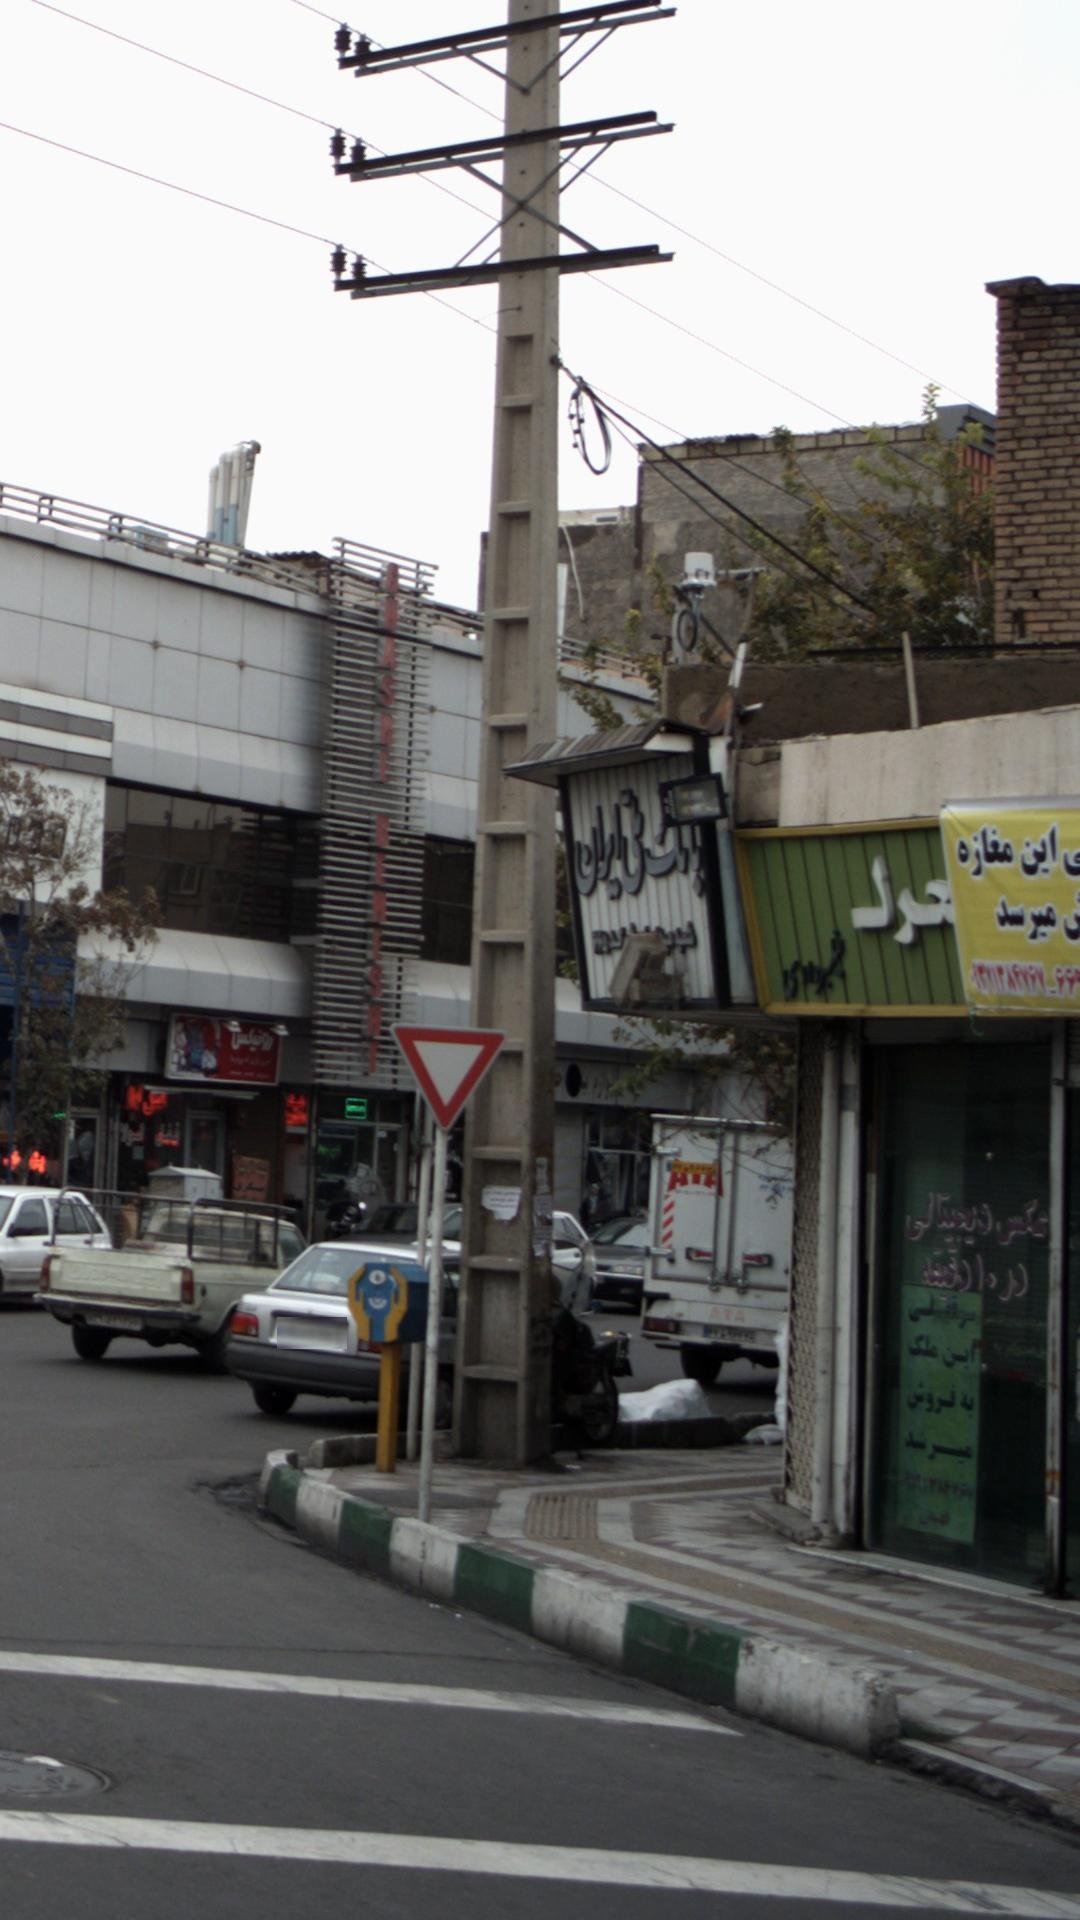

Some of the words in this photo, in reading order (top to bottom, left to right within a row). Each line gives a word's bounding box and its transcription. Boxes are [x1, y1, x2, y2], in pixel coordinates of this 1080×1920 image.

[957, 827, 1014, 876] مغازه
[1020, 825, 1057, 875] این
[996, 1199, 1049, 1245] عکس
[999, 1263, 1029, 1301] در
[908, 1334, 938, 1358] ملک
[943, 1338, 976, 1369] این
[906, 1381, 956, 1414] فروش
[960, 1392, 974, 1419] به
[905, 1432, 972, 1464] میرسد
